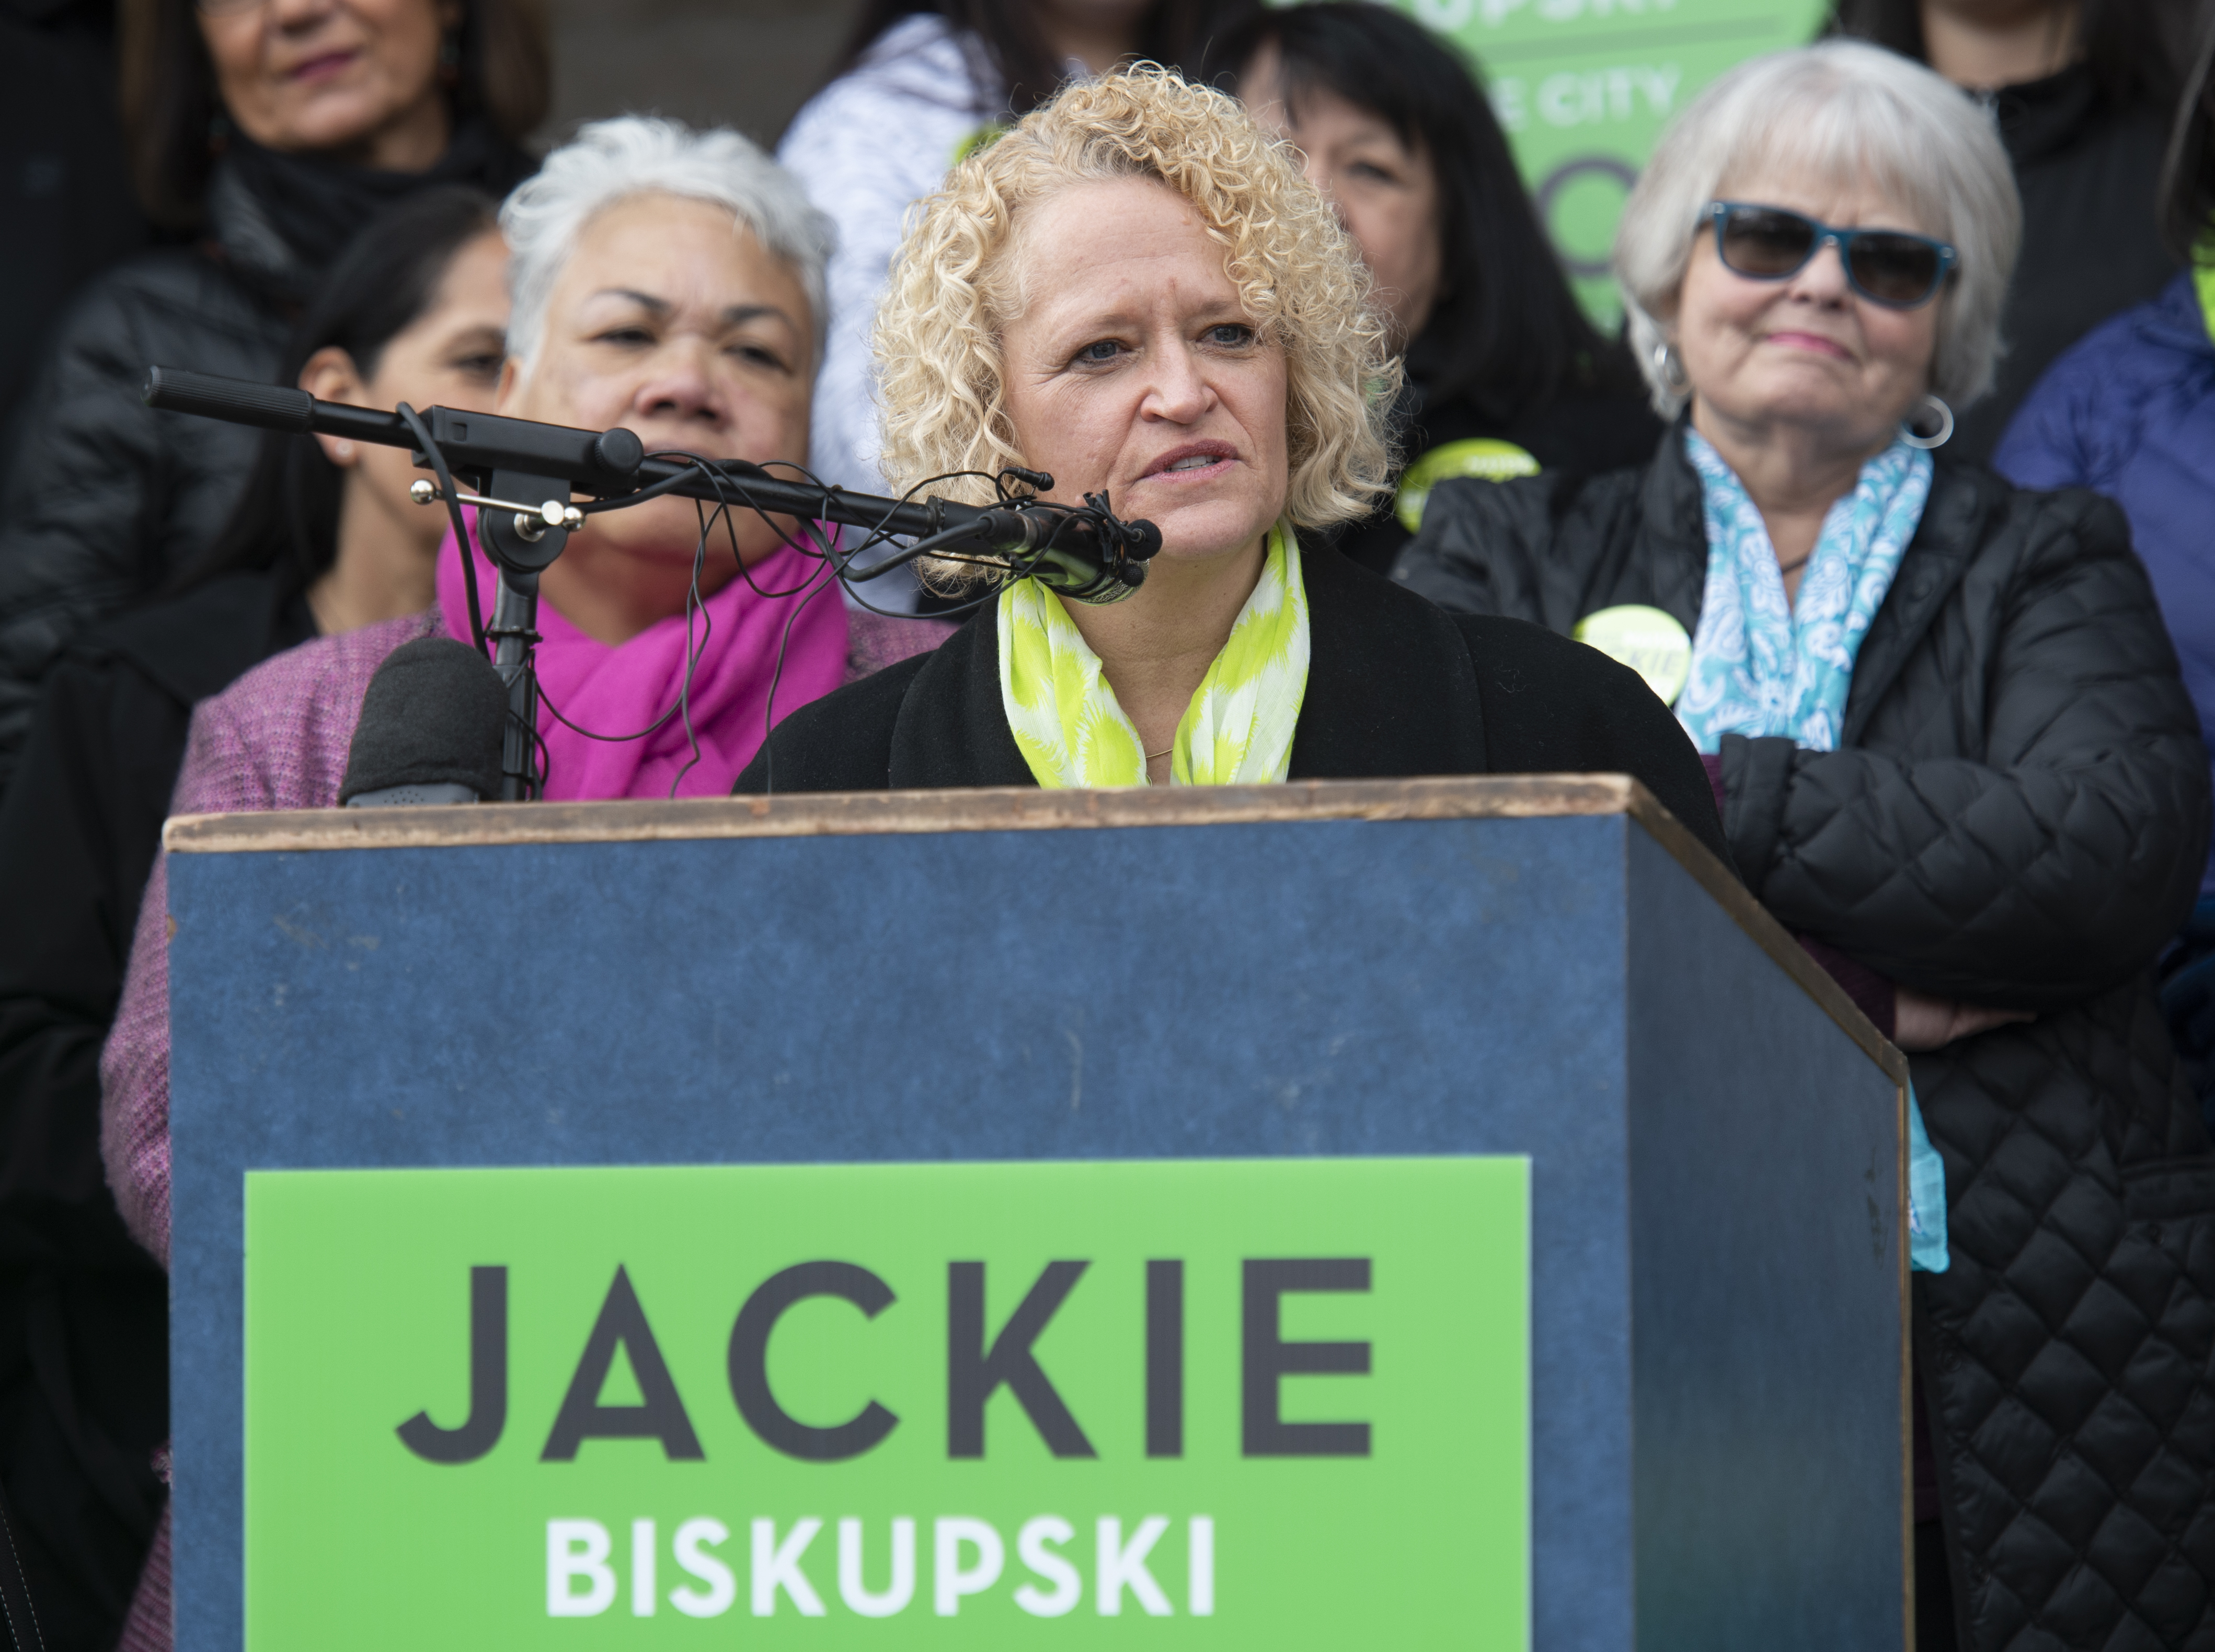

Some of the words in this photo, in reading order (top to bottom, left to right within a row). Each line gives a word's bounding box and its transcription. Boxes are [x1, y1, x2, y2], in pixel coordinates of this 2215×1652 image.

[1537, 61, 1682, 128] CITY
[395, 1257, 1372, 1465] JACKIE
[545, 1515, 1214, 1618] BISKUPSKI
